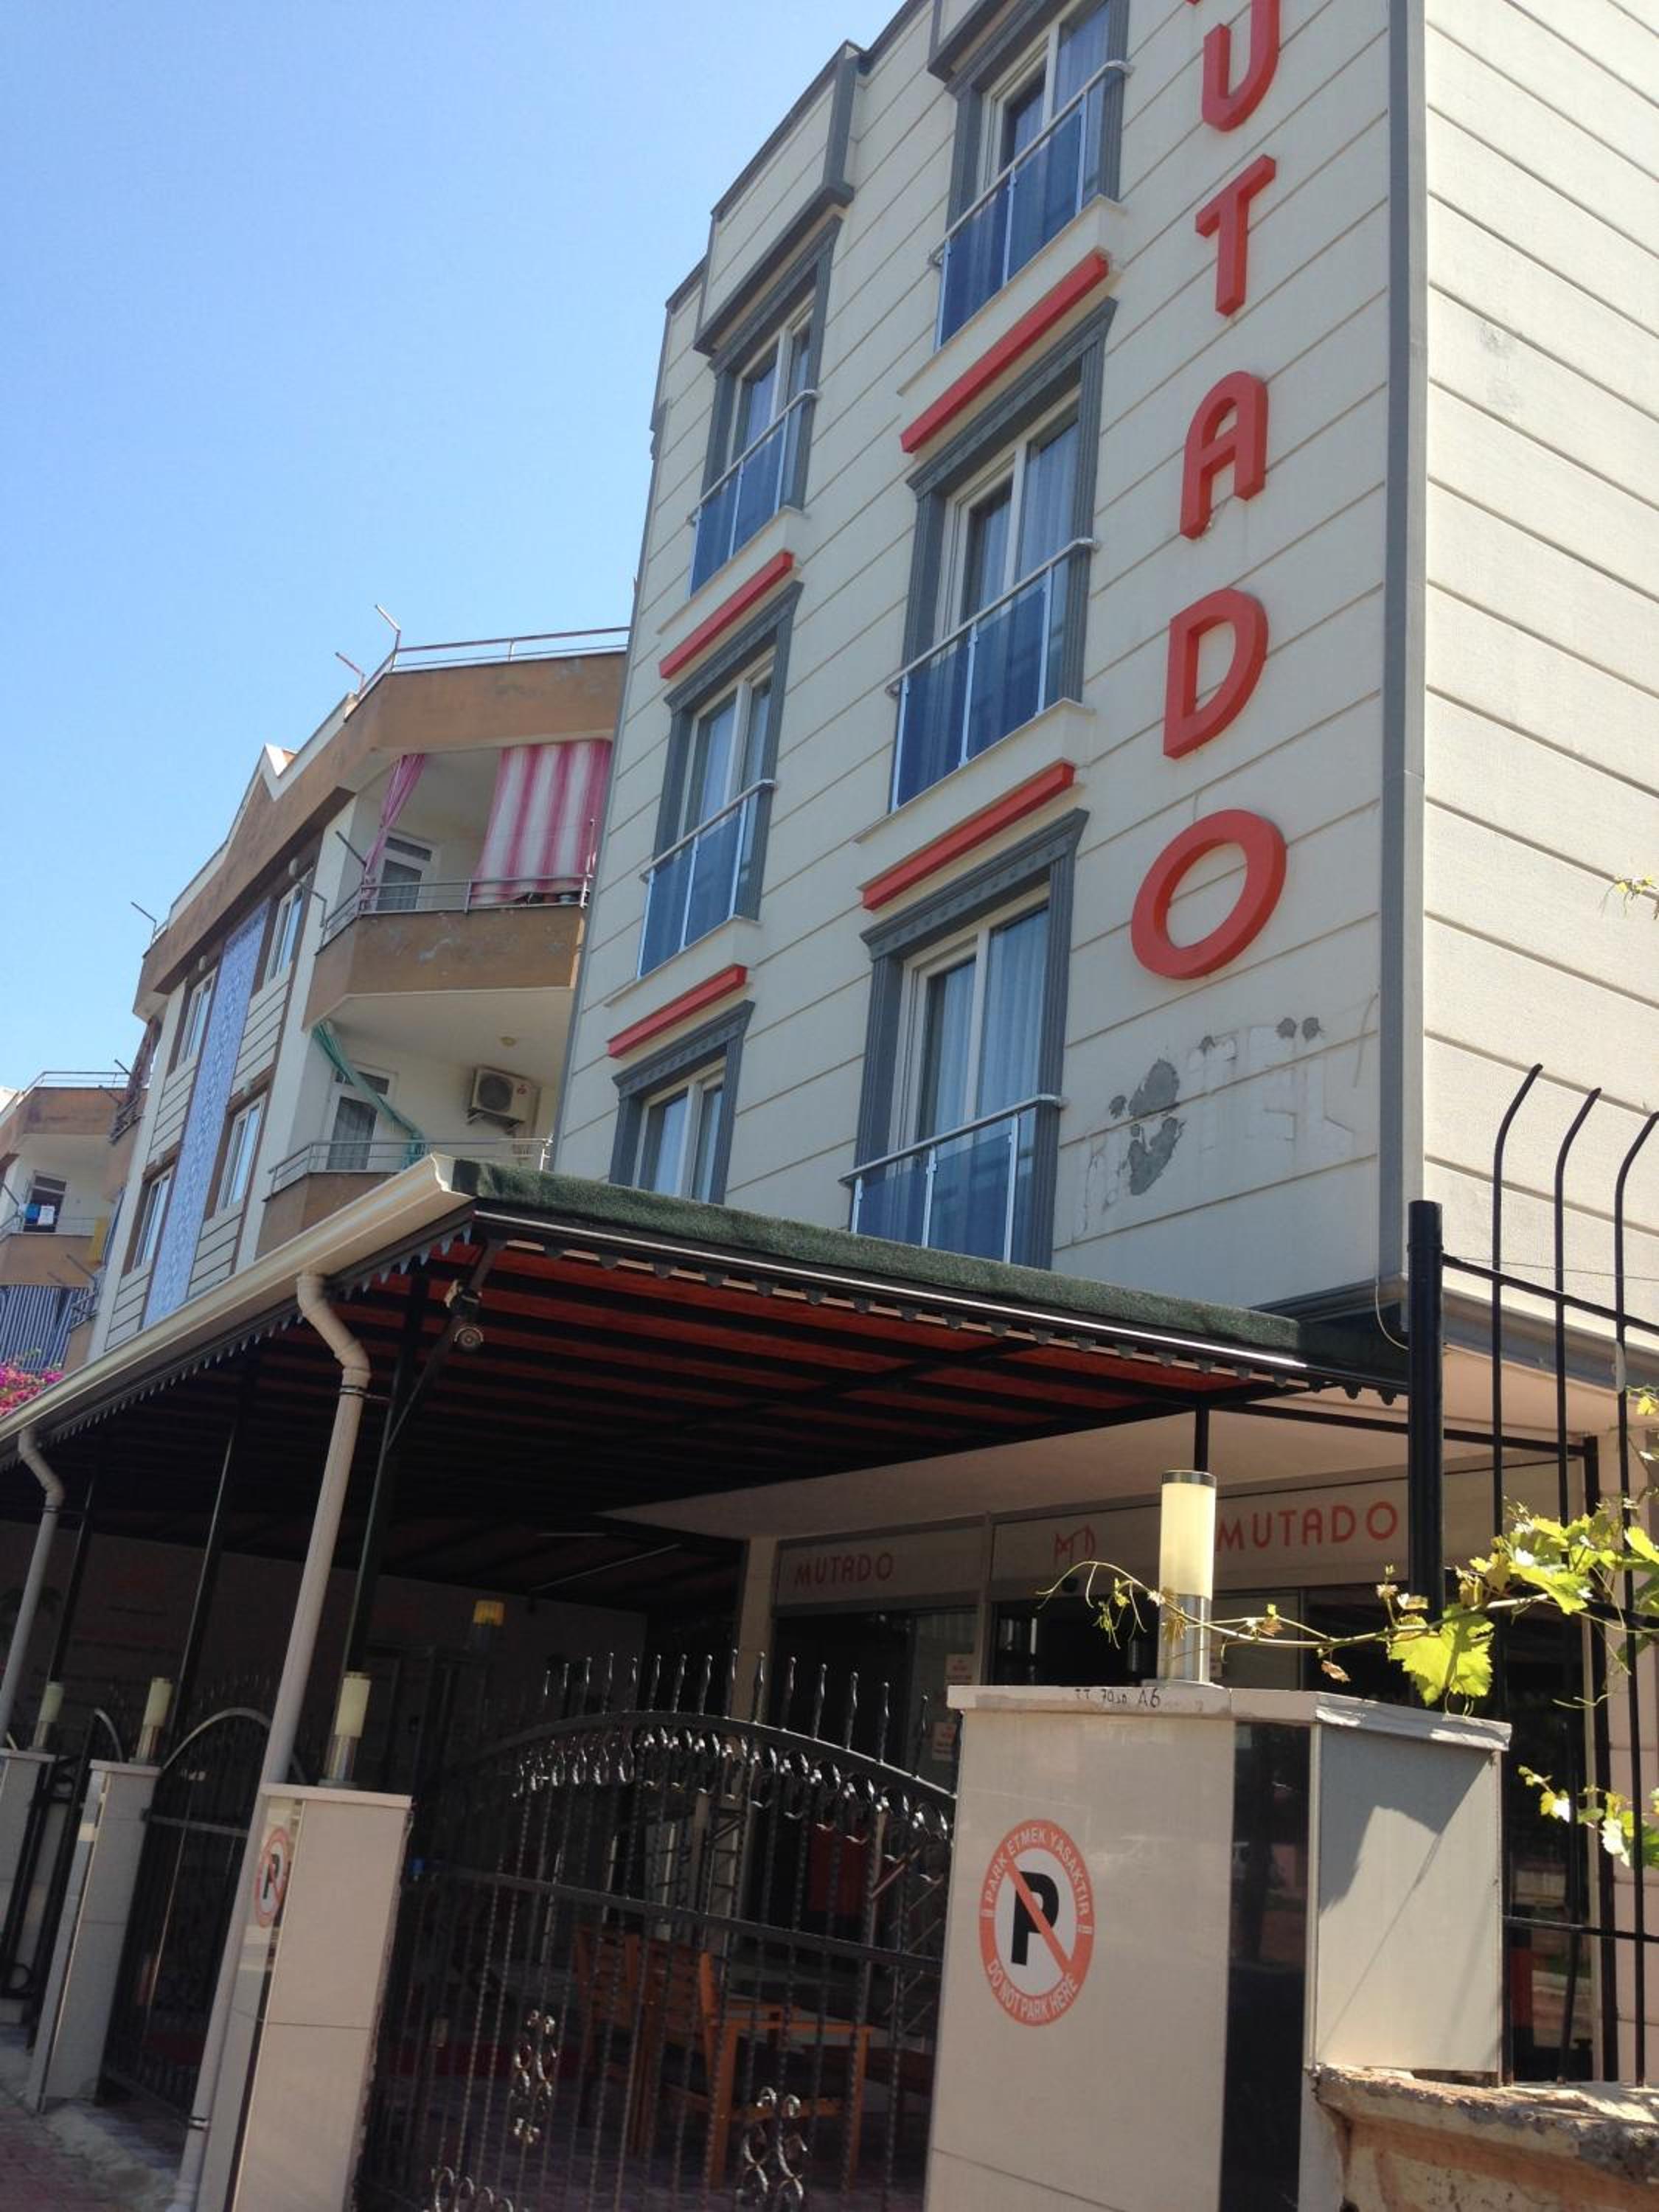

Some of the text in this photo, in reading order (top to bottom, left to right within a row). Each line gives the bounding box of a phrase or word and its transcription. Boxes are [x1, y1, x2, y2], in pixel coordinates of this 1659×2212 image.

[1131, 0, 1287, 979] UTADO
[1215, 1500, 1398, 1552] MUTADO
[794, 1552, 894, 1586] MUTADO
[983, 1828, 1090, 1916] PARK ETMEK YASAKTIR
[987, 1958, 1079, 2020] DO NOT PARK HERE
